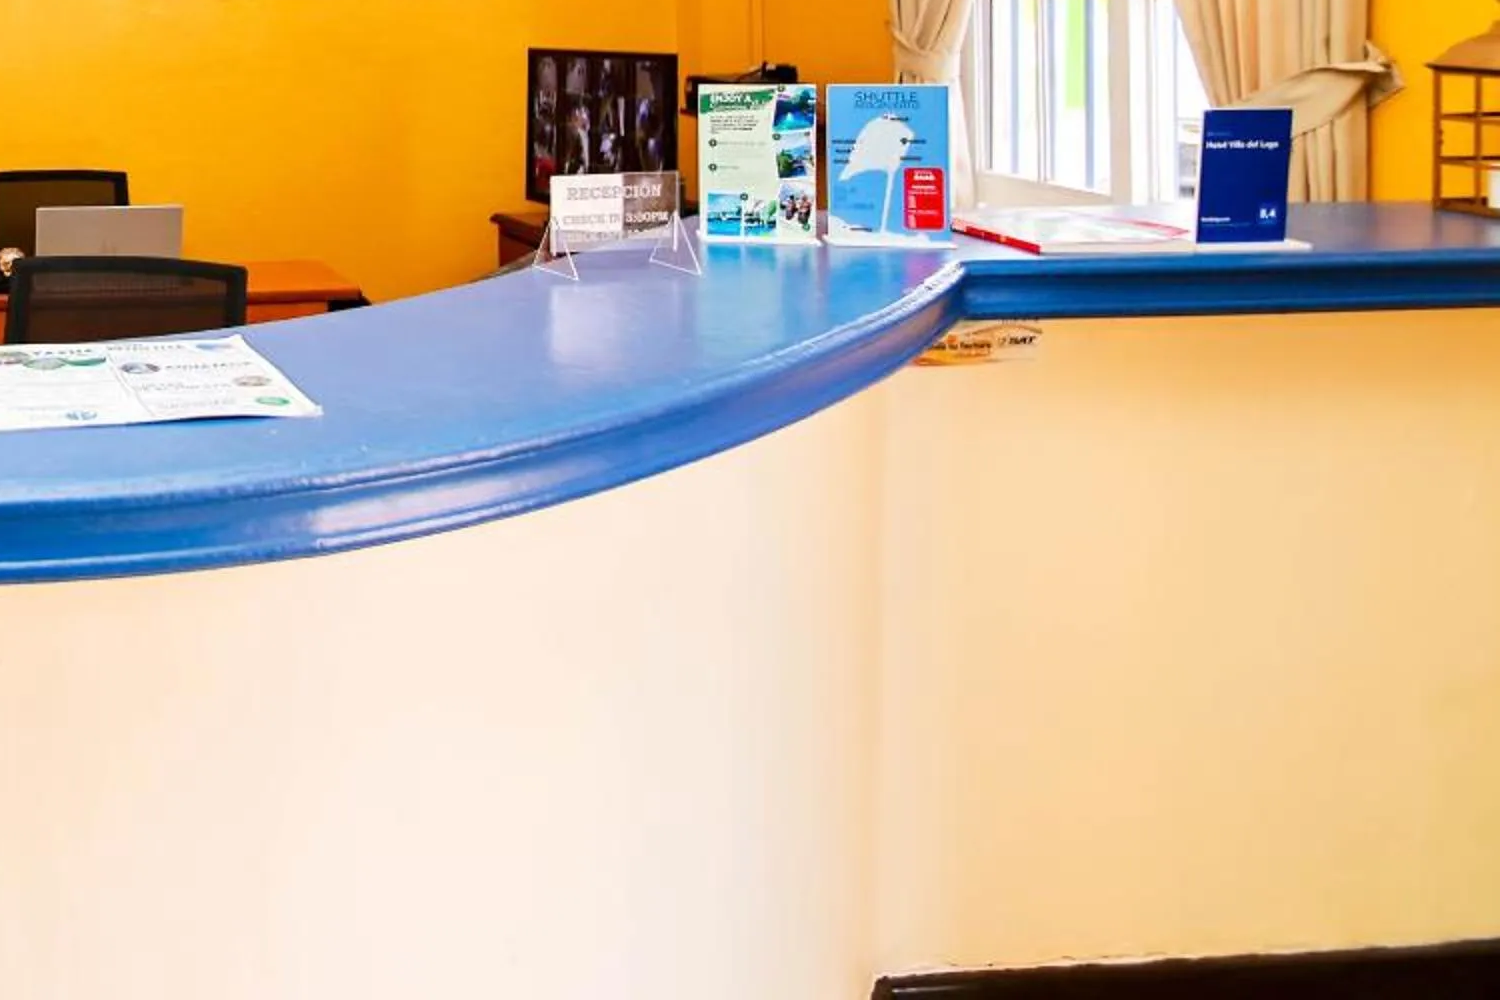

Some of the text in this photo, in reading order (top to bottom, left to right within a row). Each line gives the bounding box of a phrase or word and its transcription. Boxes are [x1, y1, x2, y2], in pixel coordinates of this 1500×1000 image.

[854, 90, 918, 103] SHUTTLE
[1206, 141, 1227, 149] Hotel
[1228, 140, 1245, 149] Villa
[1260, 140, 1279, 150] Lago
